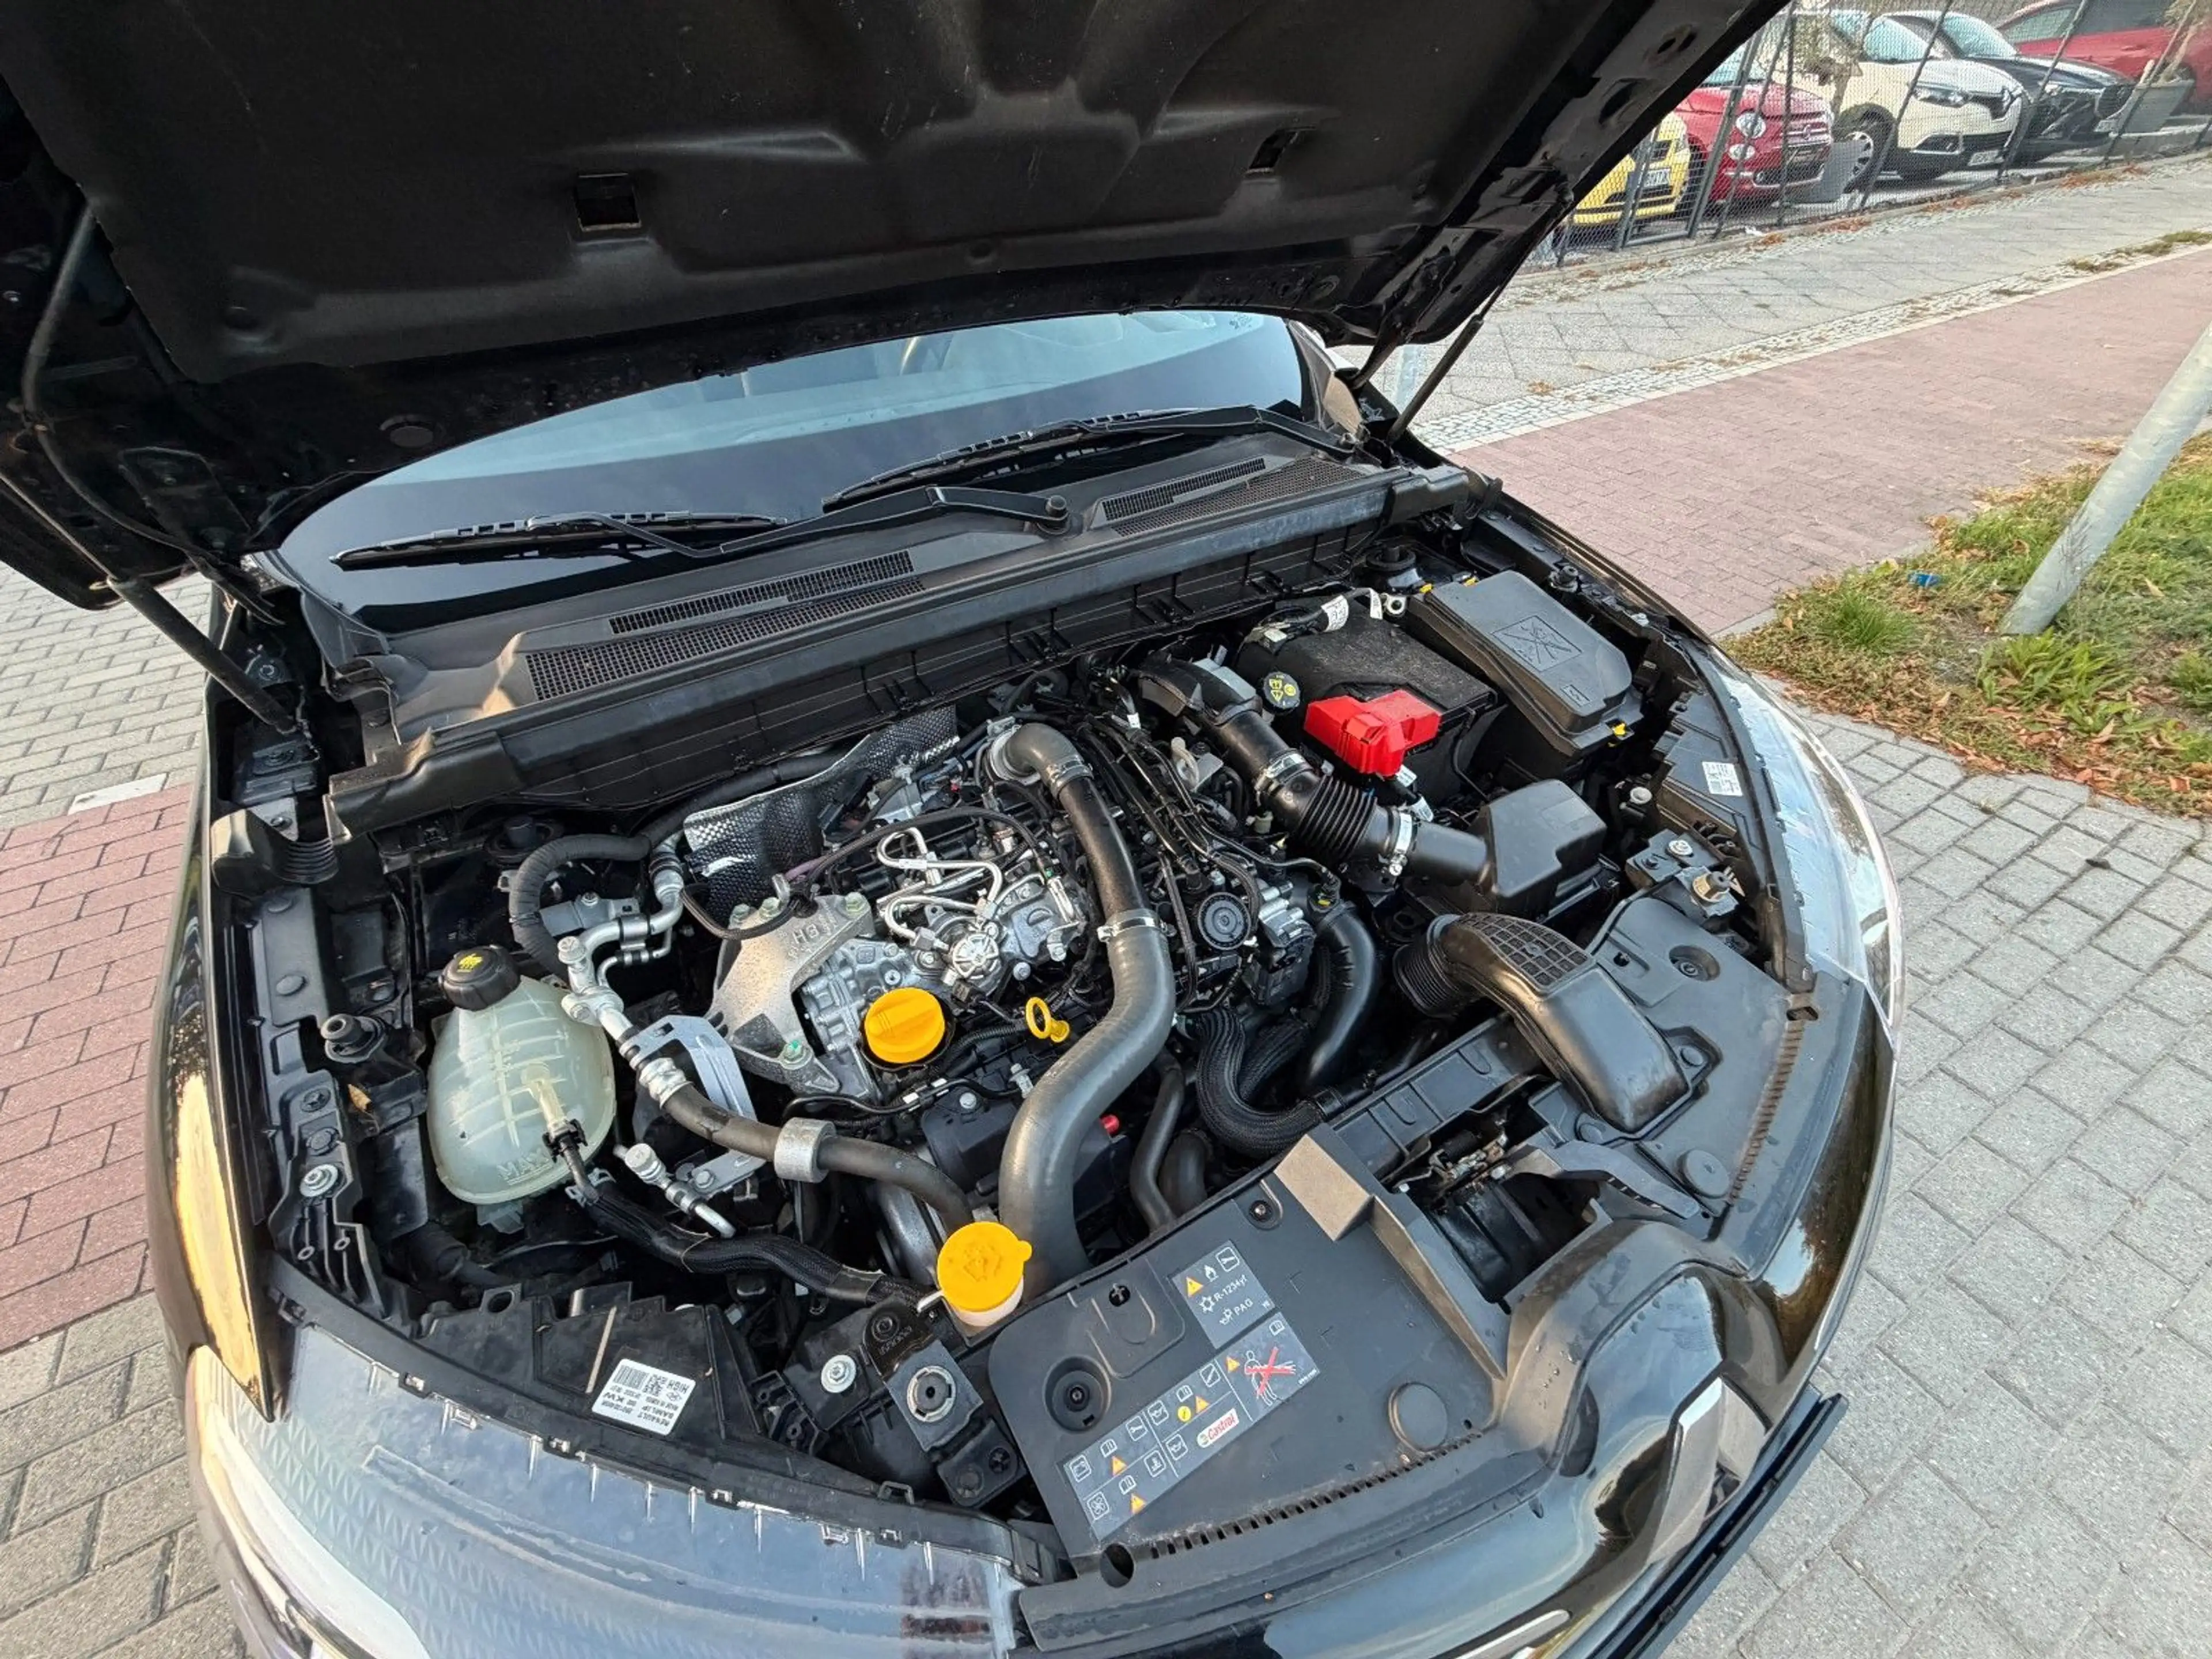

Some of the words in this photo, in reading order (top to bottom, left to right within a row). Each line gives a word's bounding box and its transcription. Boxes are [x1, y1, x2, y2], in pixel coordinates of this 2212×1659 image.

[1213, 1274, 1248, 1301] R-1234yf
[1233, 1298, 1253, 1315] PAG
[1207, 1413, 1235, 1440] Castrol
